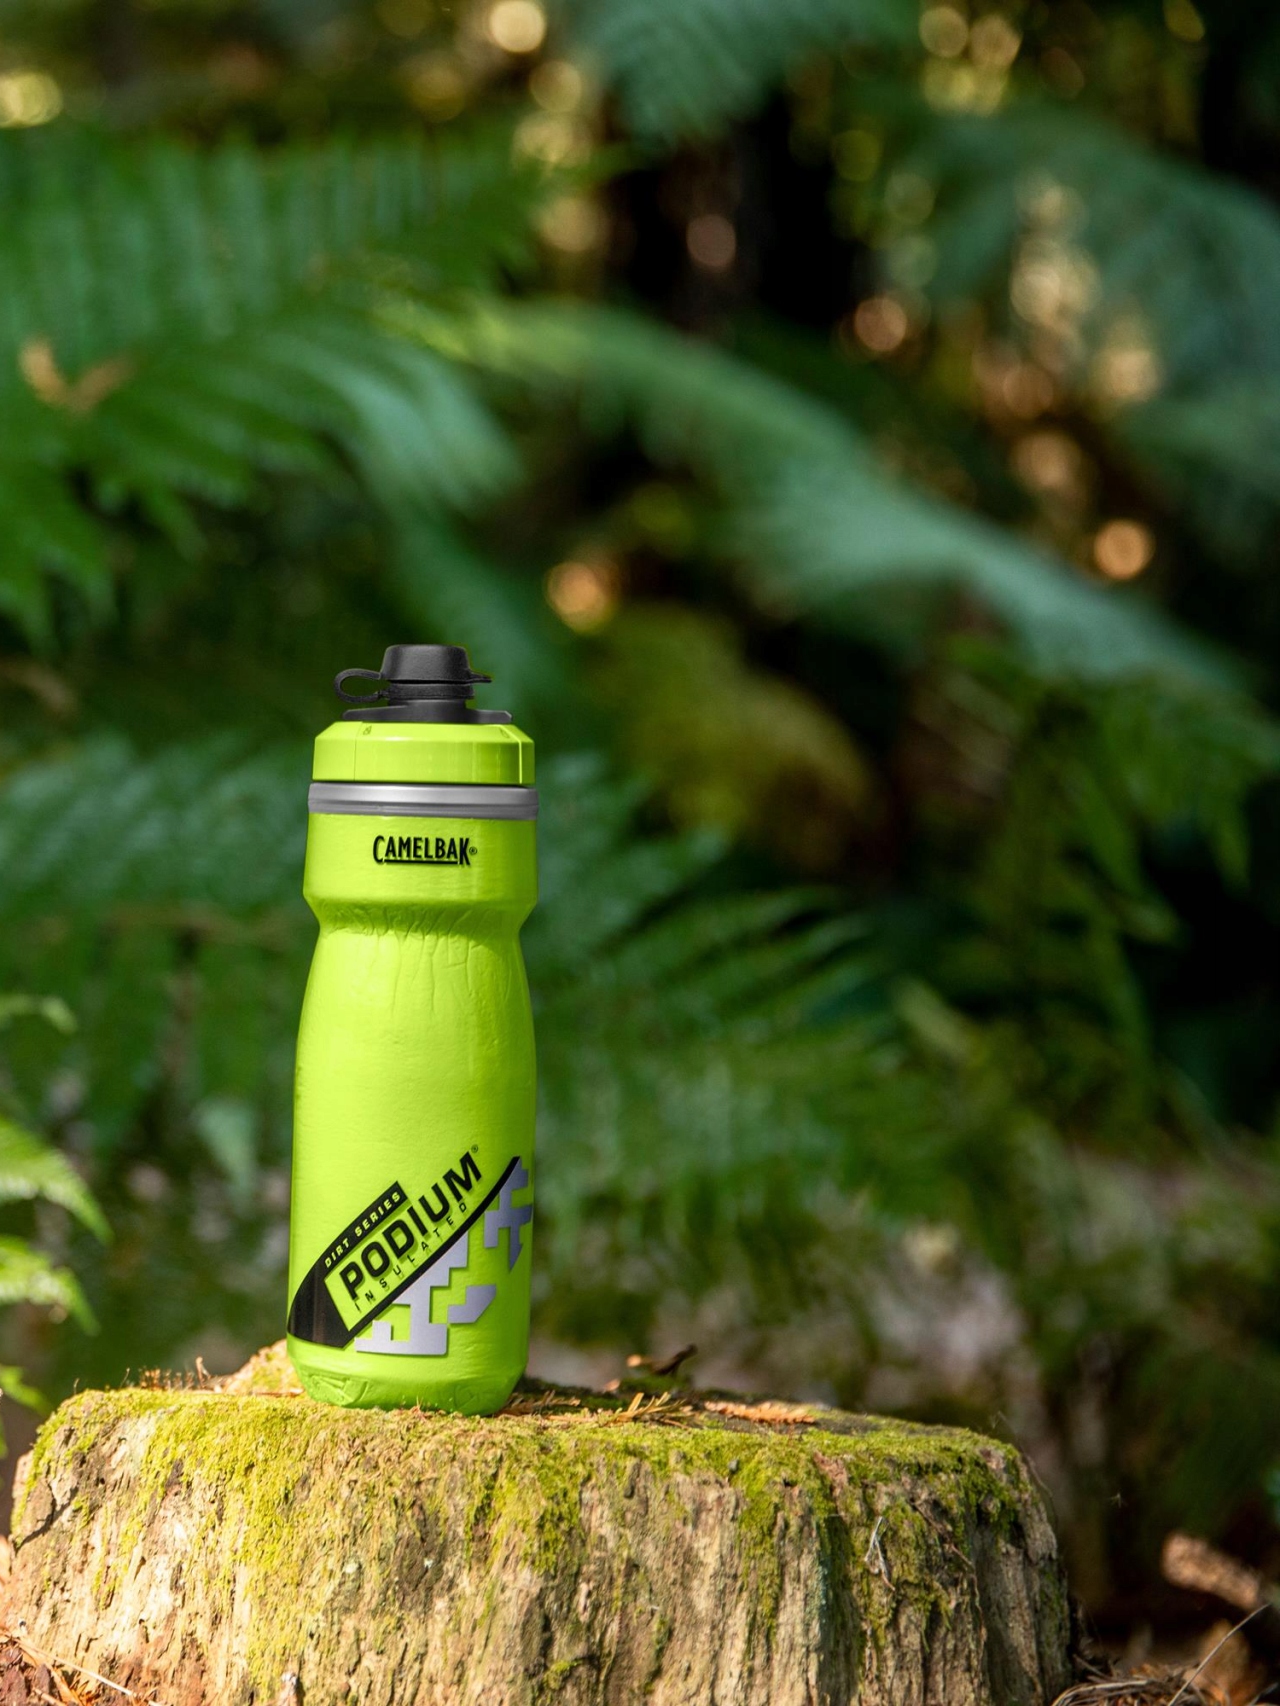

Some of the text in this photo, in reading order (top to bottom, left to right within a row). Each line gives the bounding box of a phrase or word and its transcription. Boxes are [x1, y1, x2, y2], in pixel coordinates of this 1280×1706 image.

[324, 1191, 401, 1268] DIRT SERIES
[355, 1203, 467, 1311] INSULATED
